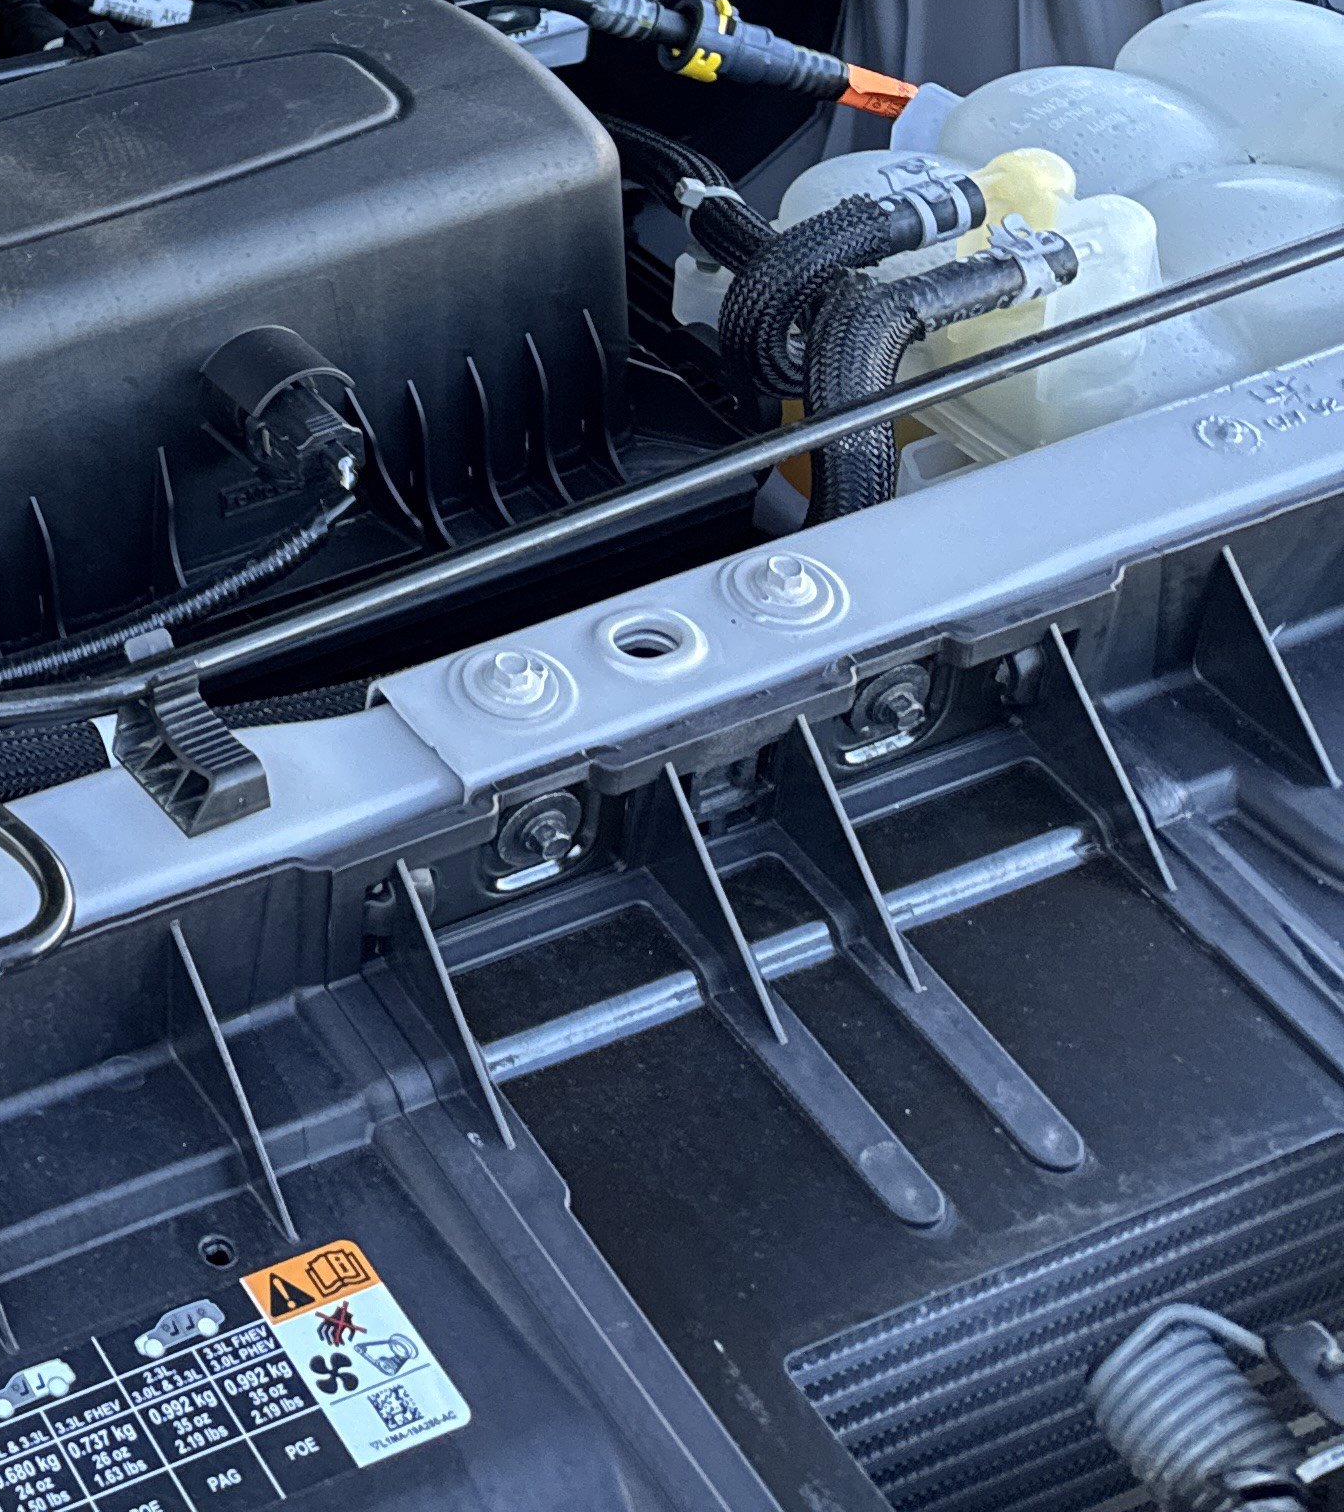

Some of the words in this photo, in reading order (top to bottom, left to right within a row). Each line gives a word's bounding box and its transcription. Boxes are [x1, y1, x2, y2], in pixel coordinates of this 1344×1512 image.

[203, 1341, 233, 1360] 3.3L
[231, 1325, 268, 1348] FHEV
[210, 1353, 240, 1372] 3.0L
[238, 1337, 277, 1361] PHEV
[131, 1385, 162, 1404] 3.0L
[161, 1379, 174, 1391] &
[173, 1368, 203, 1387] 3.3L
[223, 1366, 269, 1396] 0.992
[266, 1360, 293, 1379] kg
[148, 1396, 194, 1426] 0.992
[191, 1389, 218, 1408] kg
[248, 1388, 269, 1406] 35
[269, 1383, 289, 1398] oz
[54, 1415, 86, 1435] 3.3L
[84, 1398, 122, 1423] FHEV
[250, 1402, 281, 1425] 2.19
[279, 1395, 305, 1413] lbs
[173, 1418, 193, 1436] 35
[193, 1413, 213, 1428] oz
[7, 1440, 20, 1454] &
[18, 1430, 50, 1449] 3.3L
[67, 1428, 111, 1459] 0.737
[110, 1422, 138, 1442] kg
[174, 1433, 204, 1455] 2.19
[203, 1424, 229, 1442] lbs
[284, 1436, 321, 1462] POE
[35, 1453, 62, 1473] kg
[91, 1450, 112, 1470] 26
[112, 1445, 132, 1461] oz
[93, 1465, 124, 1488] 1.63
[122, 1459, 148, 1476] lbs
[206, 1468, 243, 1493] PAG
[14, 1482, 36, 1501] 24
[35, 1476, 56, 1492] oz
[17, 1497, 48, 1512] 50
[46, 1489, 72, 1508] lbs
[129, 1499, 164, 1512] OE
